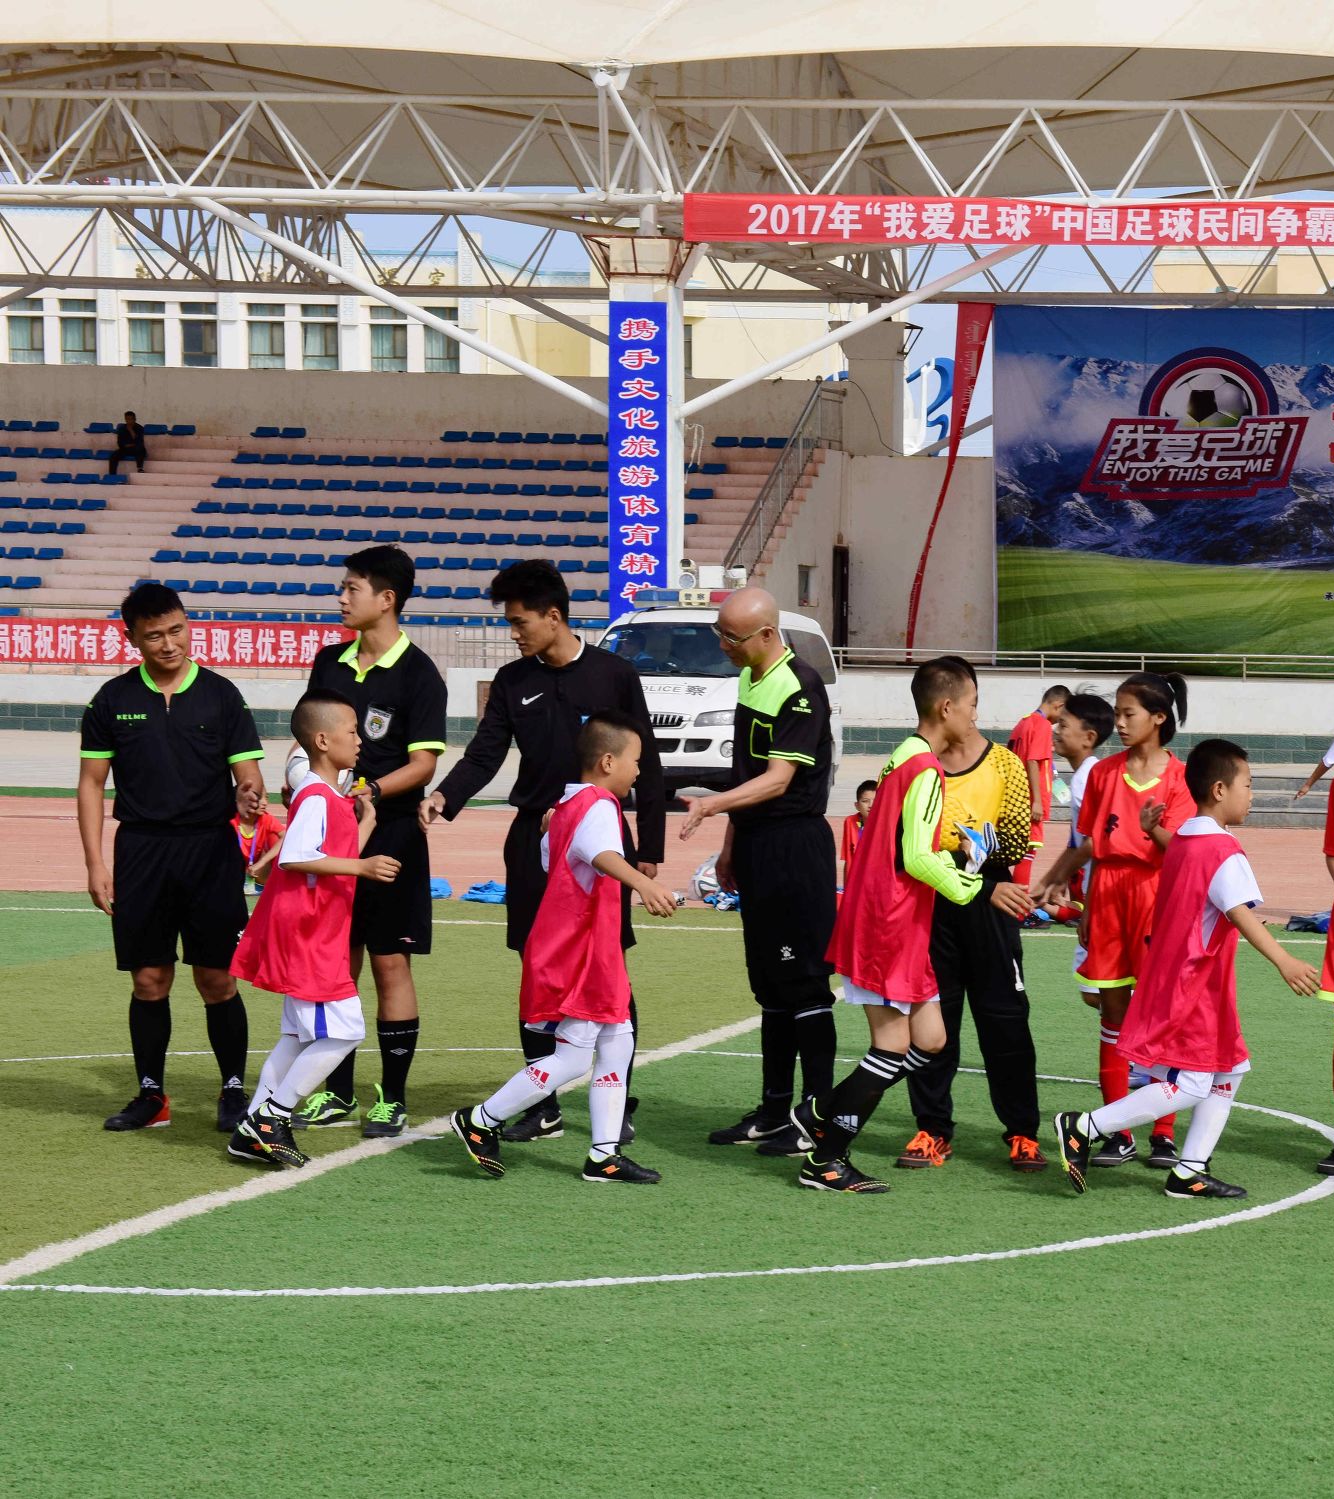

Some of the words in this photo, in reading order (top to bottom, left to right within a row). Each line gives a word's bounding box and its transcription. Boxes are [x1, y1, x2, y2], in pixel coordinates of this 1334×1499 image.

[1107, 421, 1287, 468] 我爱足球
[1102, 460, 1161, 482] ENJOY
[1168, 468, 1210, 482] THIS
[1214, 458, 1274, 481] GAME
[641, 684, 682, 693] OLICE
[116, 713, 147, 721] KELME
